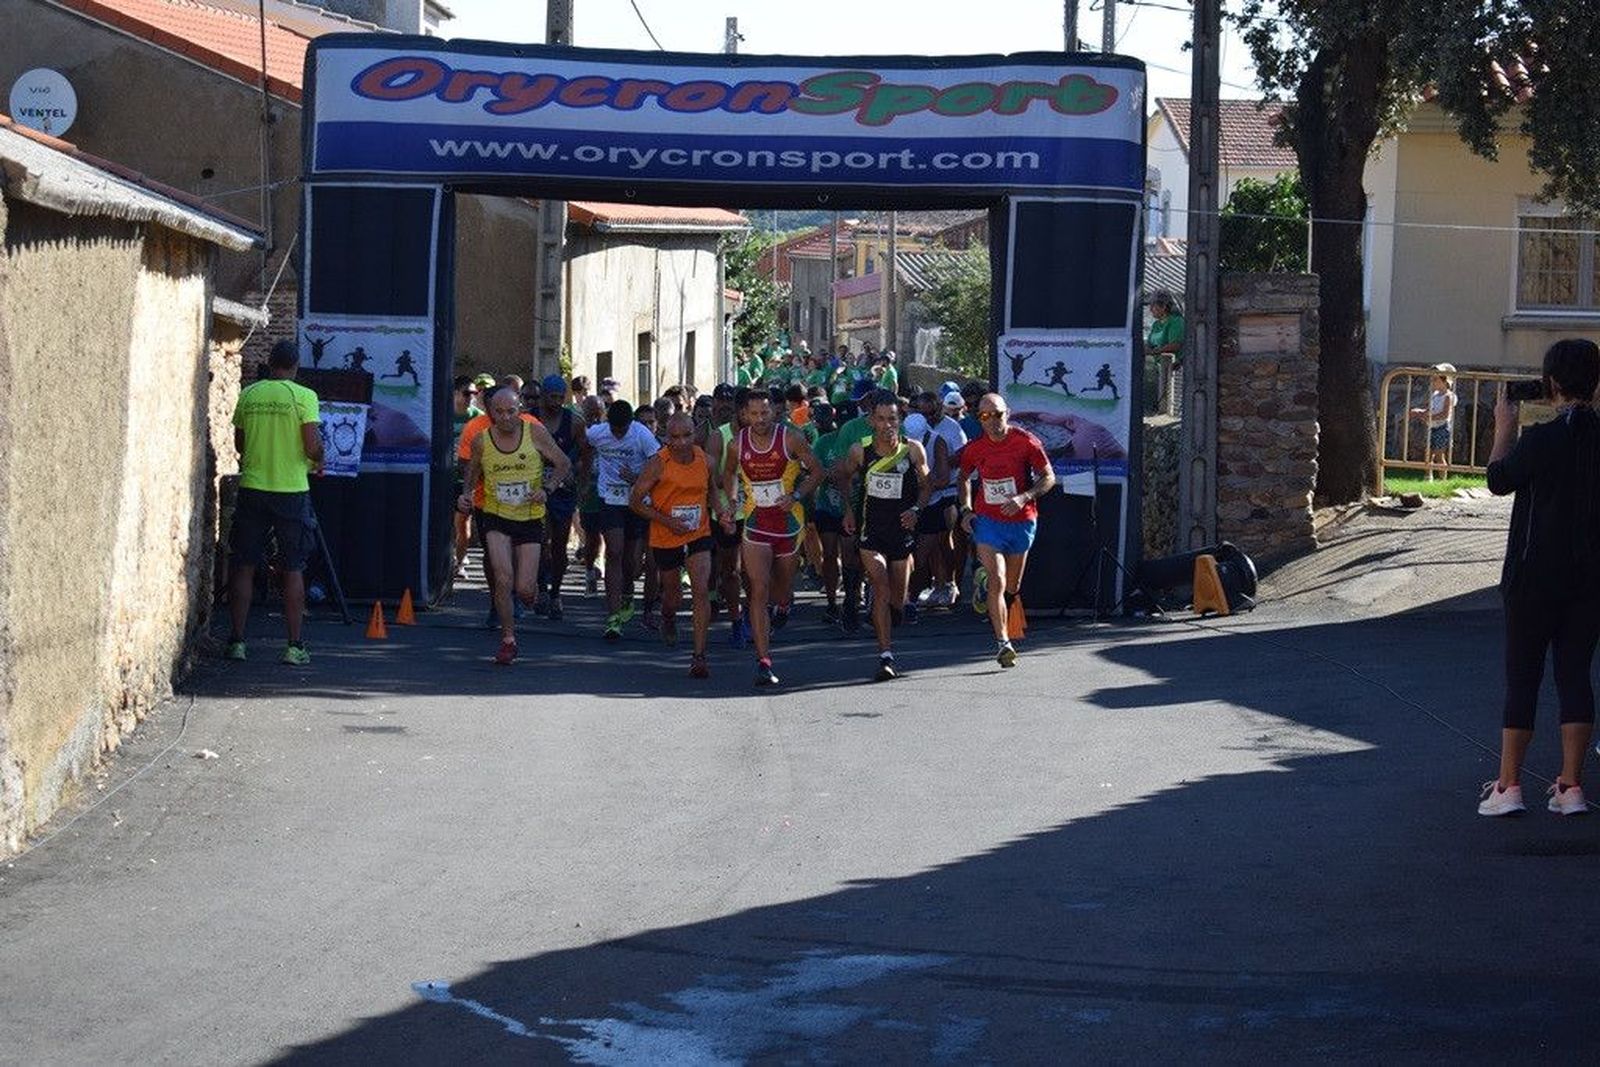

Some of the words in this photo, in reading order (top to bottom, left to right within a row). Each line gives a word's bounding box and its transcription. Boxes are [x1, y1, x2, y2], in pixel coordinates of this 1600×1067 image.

[350, 56, 1119, 126] OrycronSport
[19, 107, 67, 118] VENTEL
[429, 138, 1040, 172] www.orycronsport.com
[876, 479, 892, 489] 65
